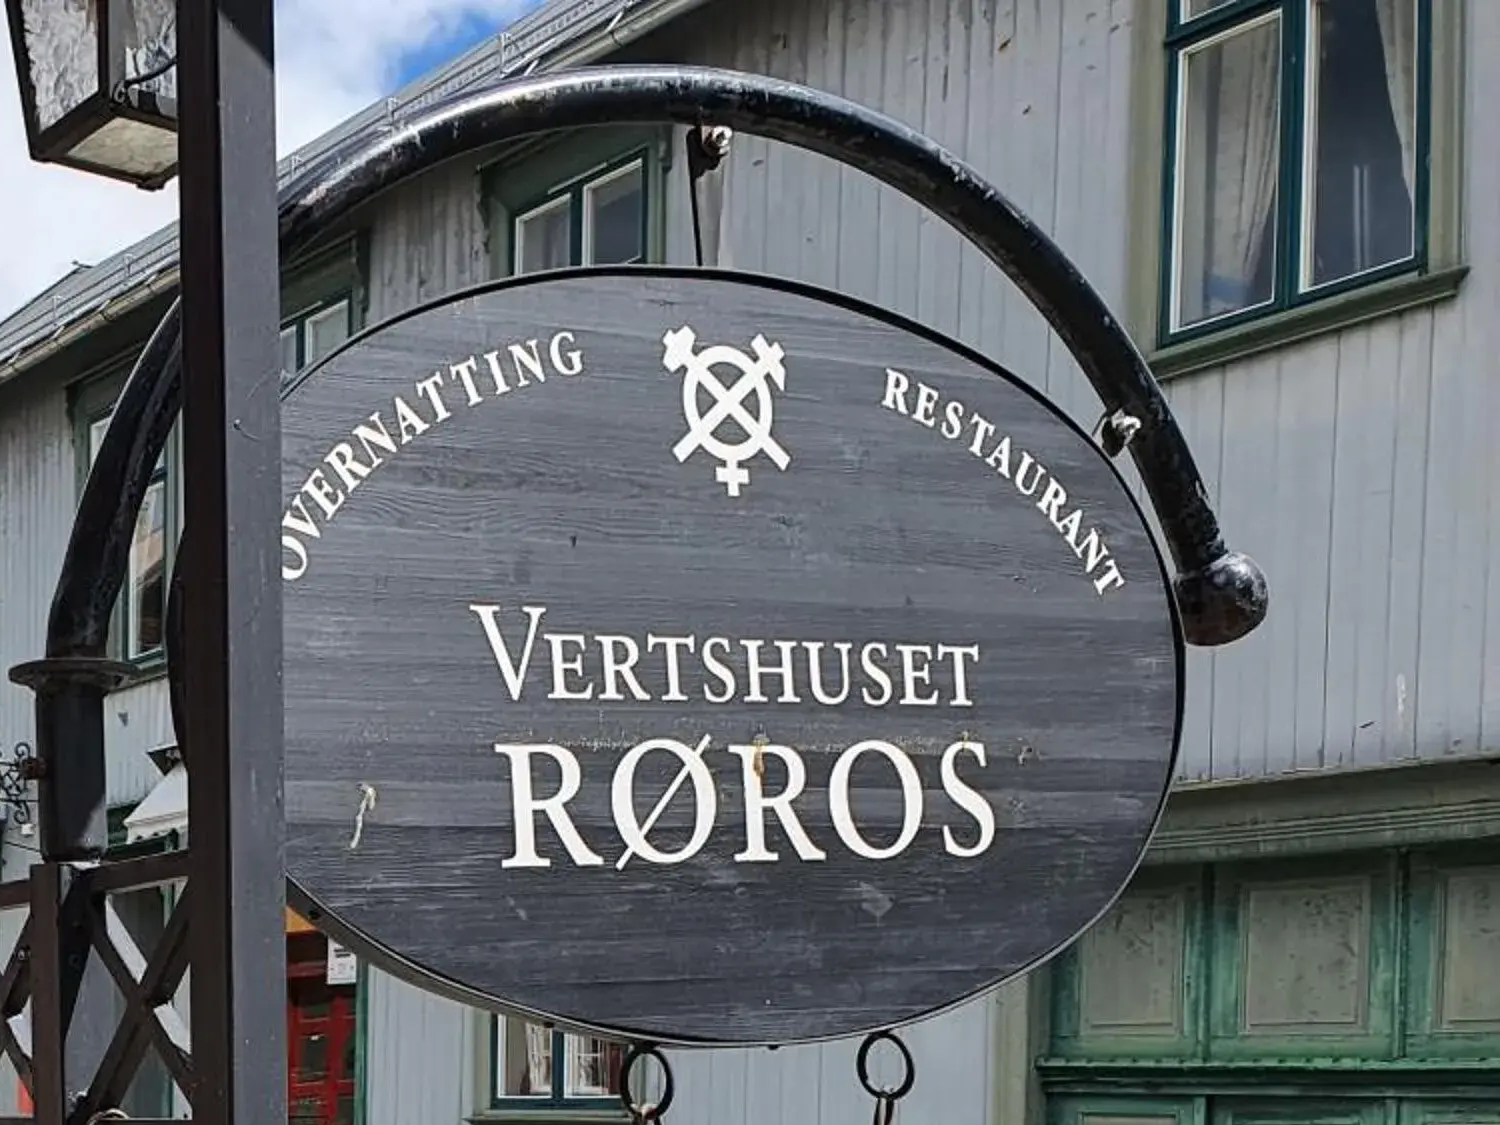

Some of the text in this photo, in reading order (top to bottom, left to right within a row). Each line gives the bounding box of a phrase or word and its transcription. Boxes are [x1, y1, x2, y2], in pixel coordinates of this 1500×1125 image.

[881, 368, 1125, 595] RESTAURANT
[469, 603, 979, 707] VERTSHUSET
[494, 733, 996, 872] RØROS
